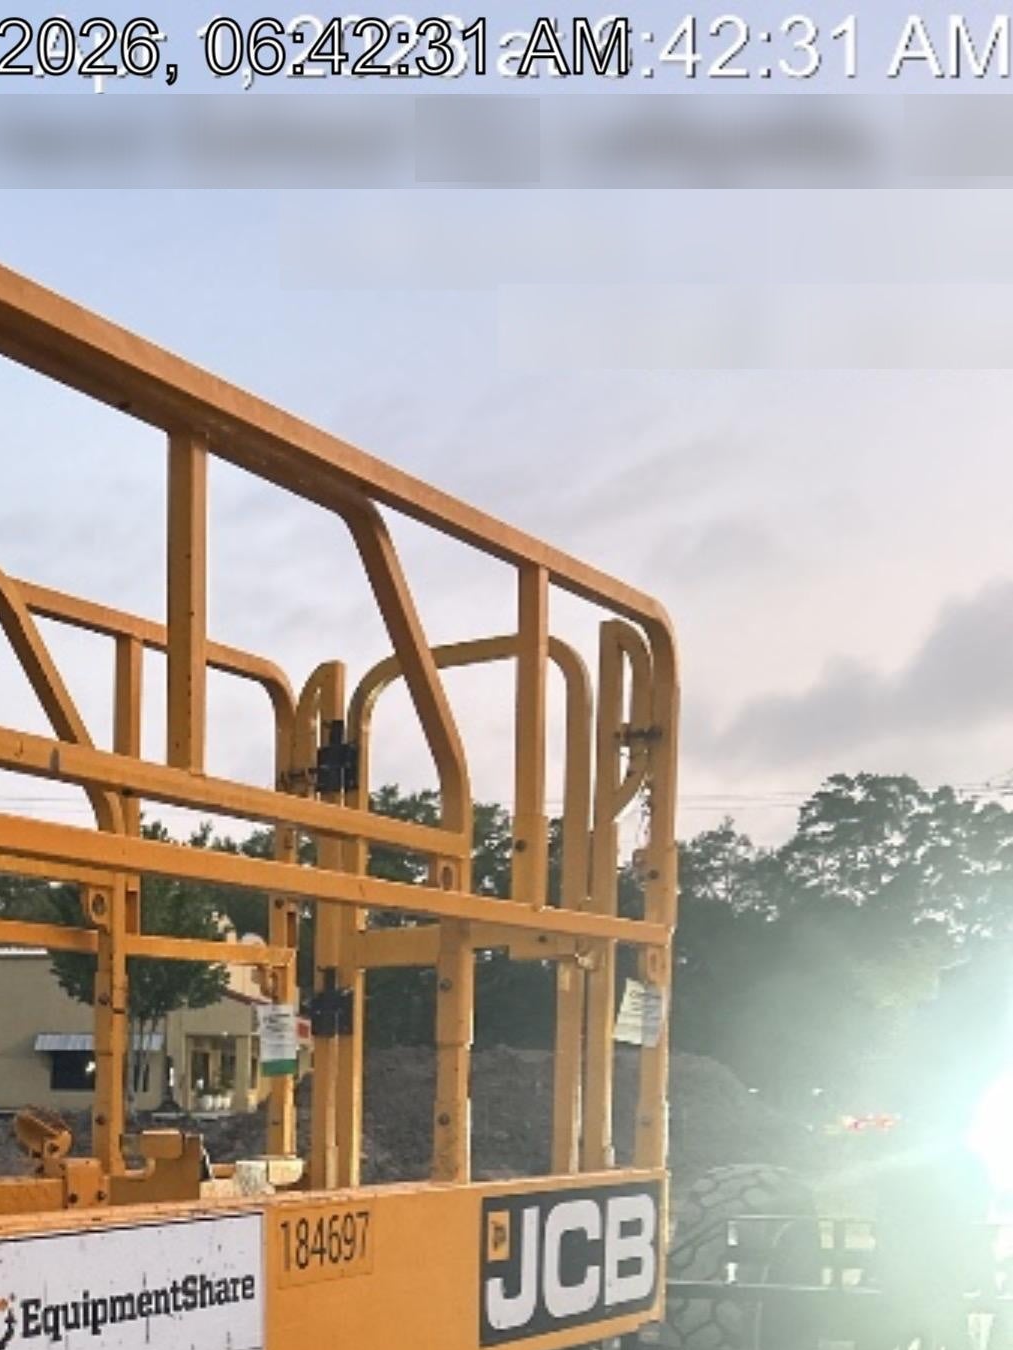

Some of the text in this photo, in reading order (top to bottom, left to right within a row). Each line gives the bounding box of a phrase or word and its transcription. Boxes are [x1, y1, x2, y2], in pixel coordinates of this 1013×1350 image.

[279, 1211, 370, 1273] 184697
[485, 1193, 657, 1331] JCB
[19, 1273, 256, 1342] EquipmentShare
